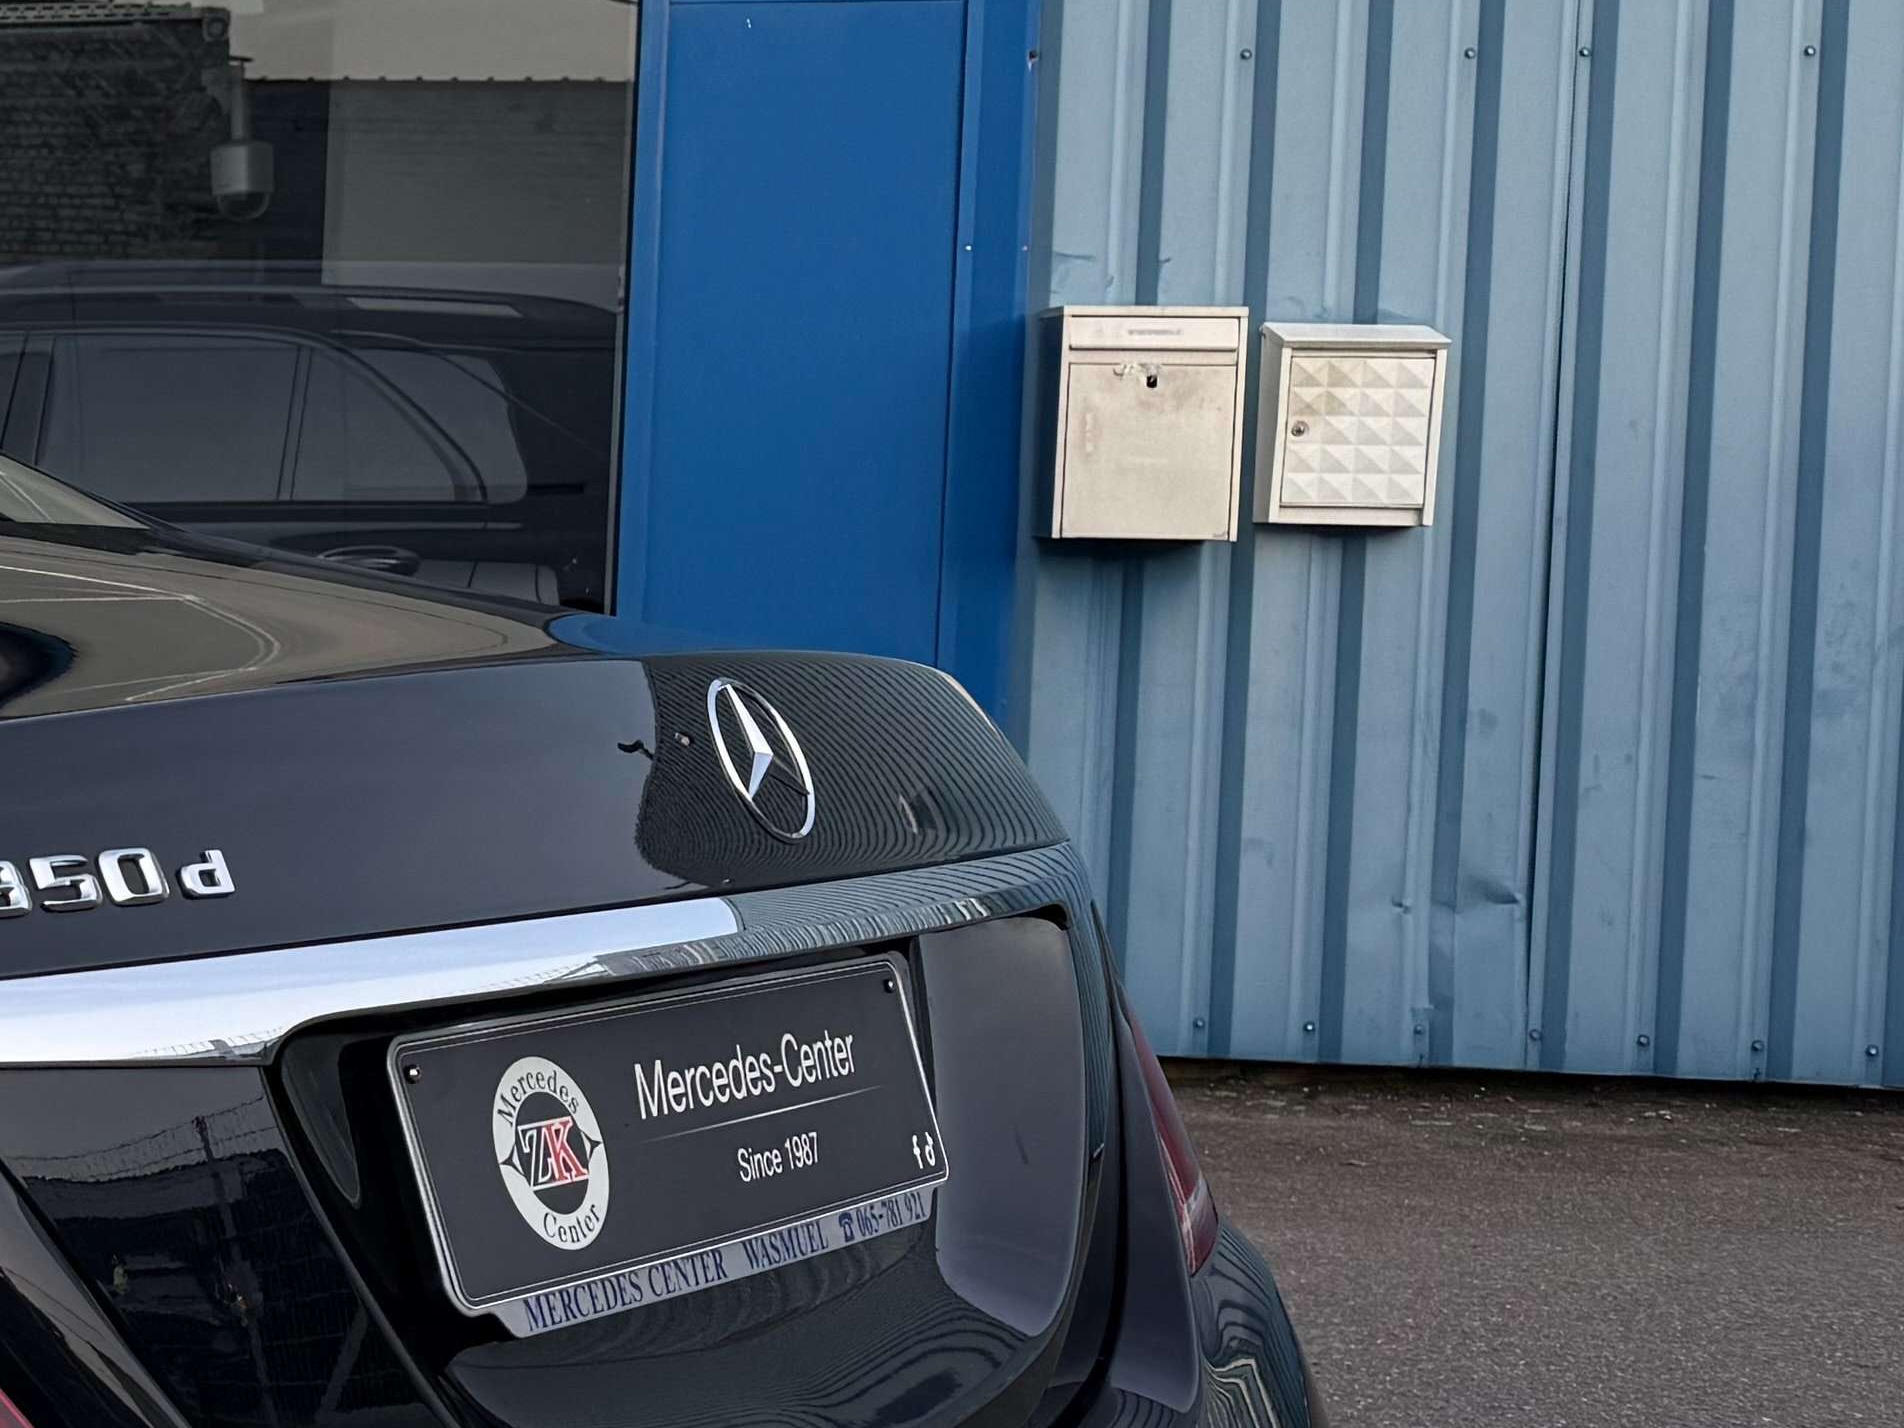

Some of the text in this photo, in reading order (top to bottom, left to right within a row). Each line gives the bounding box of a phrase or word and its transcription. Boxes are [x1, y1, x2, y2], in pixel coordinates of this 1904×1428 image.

[178, 848, 236, 900] d
[496, 1069, 580, 1127] Mercedes
[634, 1029, 856, 1120] Mercedes-Center
[737, 1131, 820, 1183] Since 1987
[543, 1203, 601, 1244] Center
[523, 1271, 643, 1333] MERCEDES
[649, 1250, 729, 1296] CENTER
[741, 1220, 830, 1270] WASMUEL
[904, 1190, 926, 1222] 921
